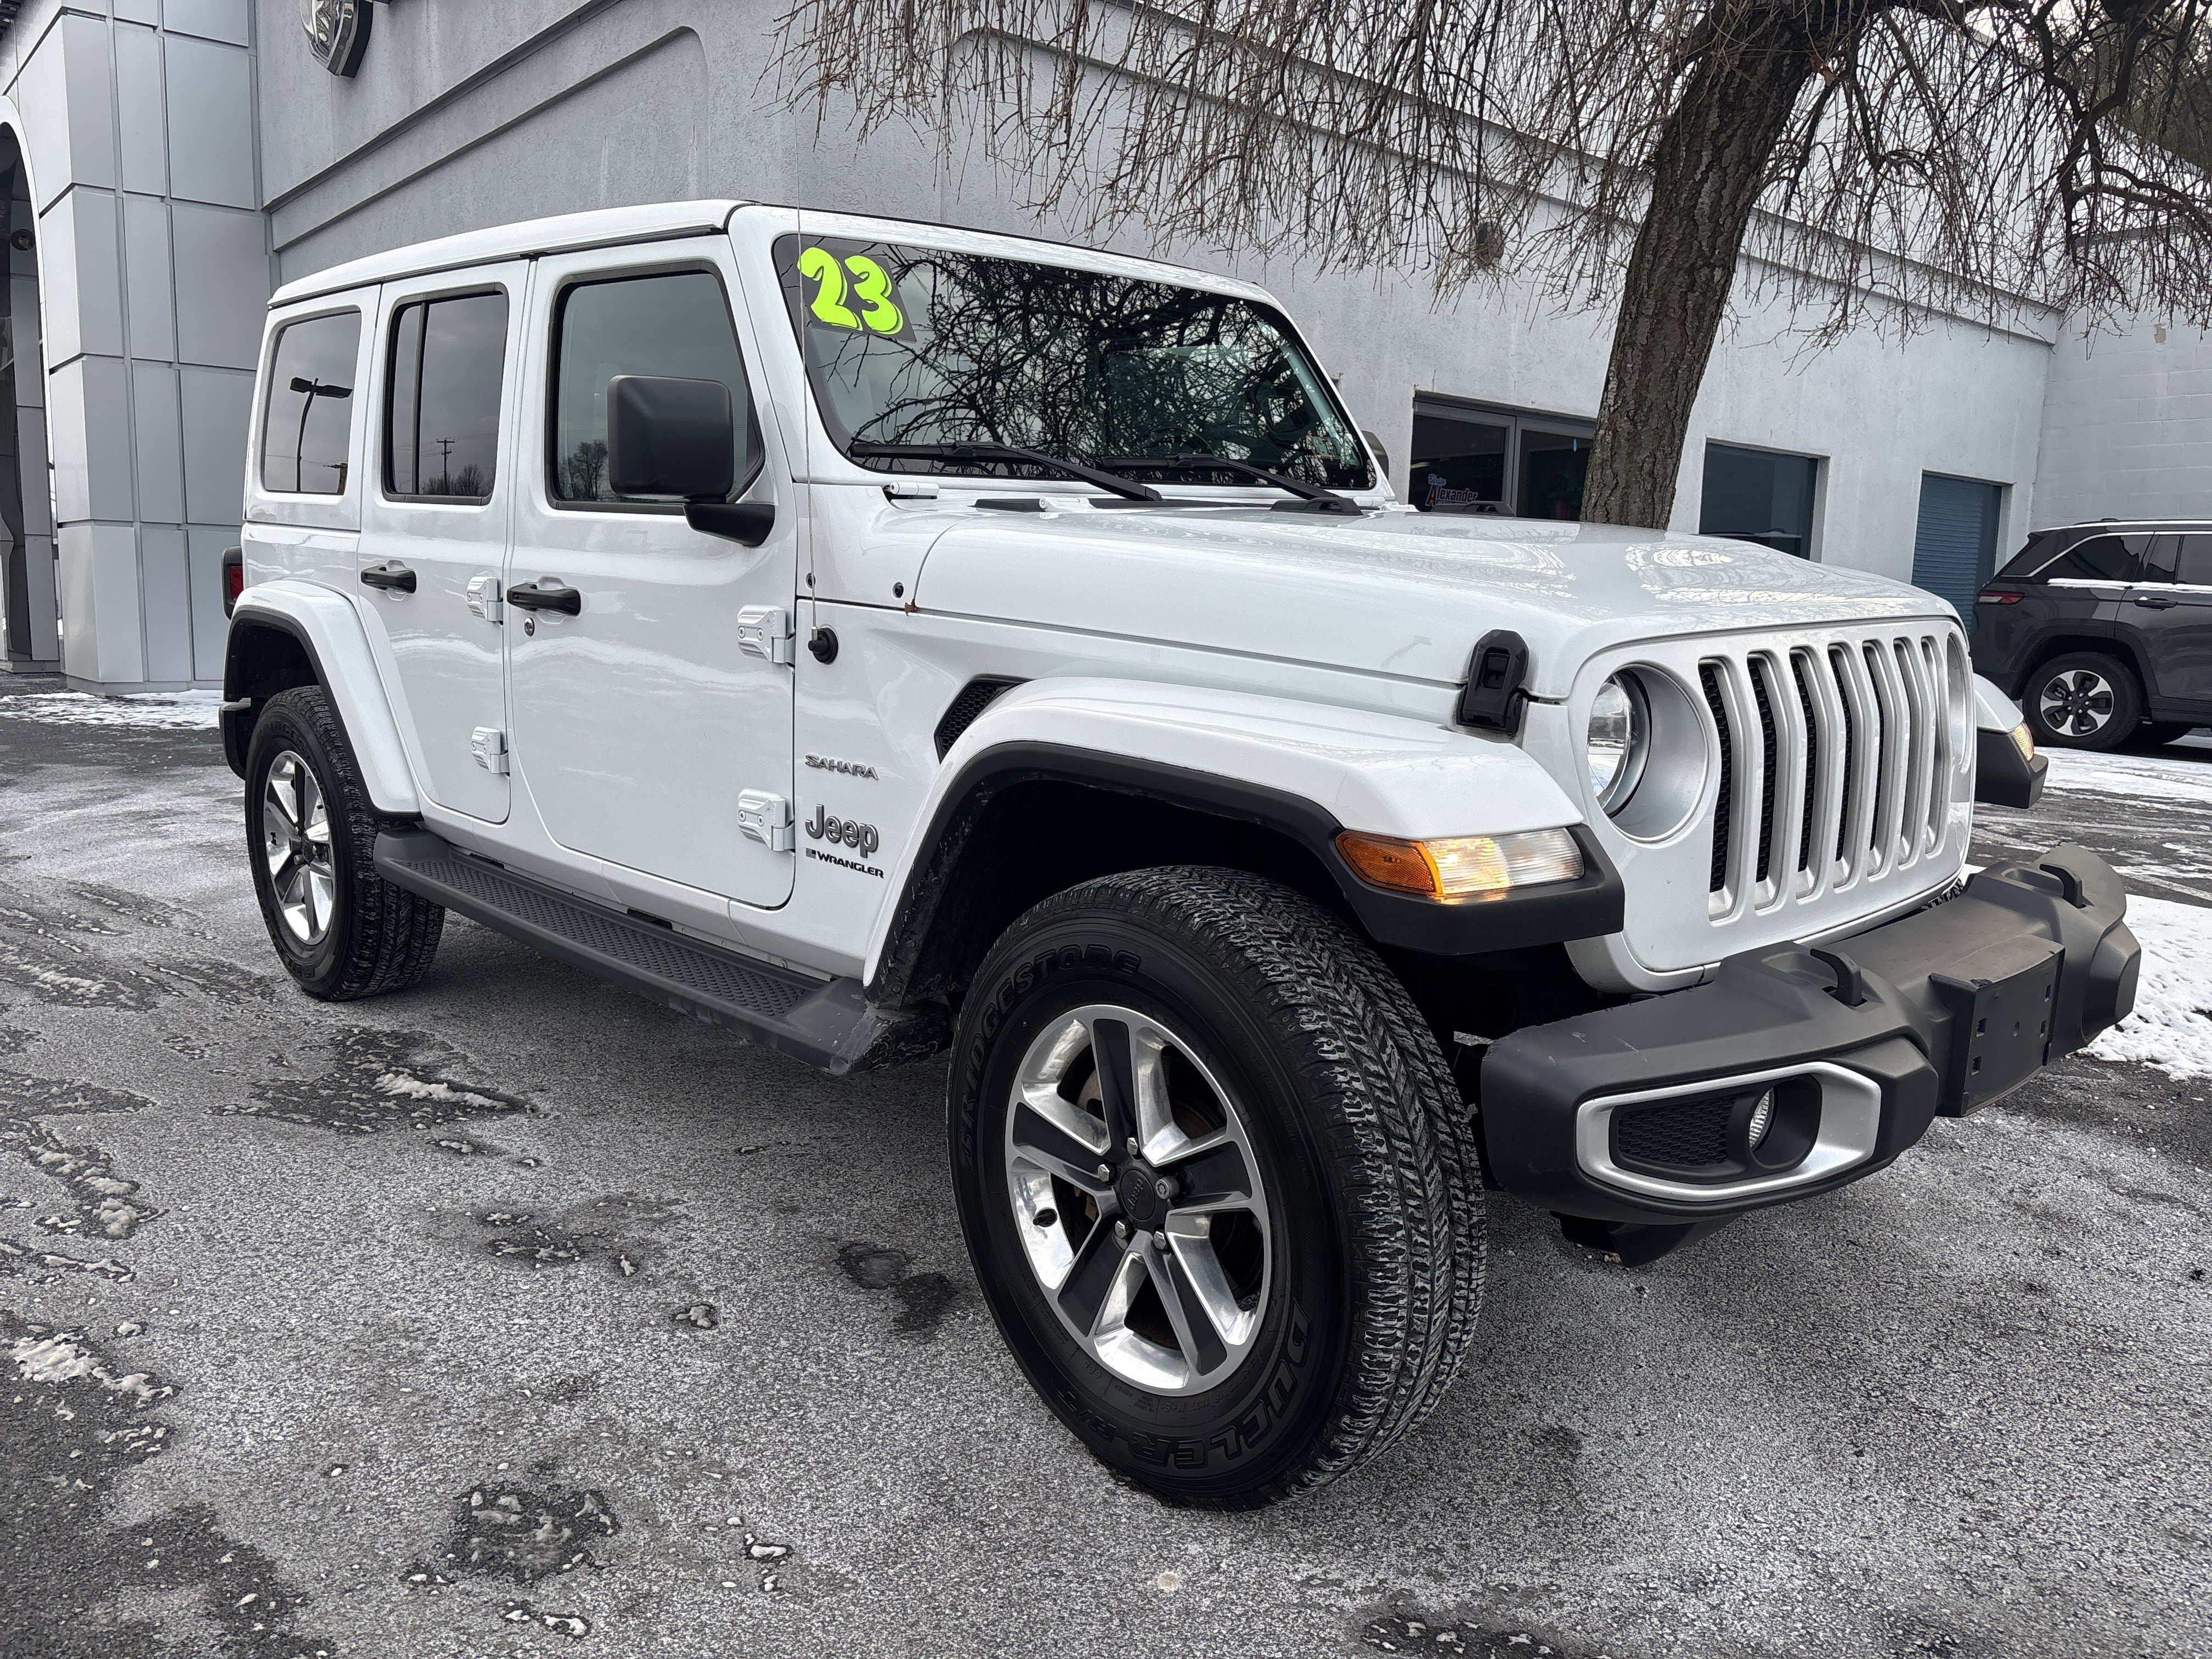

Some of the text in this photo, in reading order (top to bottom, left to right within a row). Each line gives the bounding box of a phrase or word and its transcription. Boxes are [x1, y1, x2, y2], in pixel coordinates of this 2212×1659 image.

[797, 247, 903, 335] 23
[1426, 484, 1478, 506] Alexander
[805, 754, 879, 780] SAHARA
[804, 804, 879, 859] Jeep
[816, 850, 884, 879] WRANGLER
[959, 944, 1142, 1171] BRIDGESTONE
[1127, 1178, 1144, 1212] Jeep
[1127, 1298, 1312, 1469] DUELER
